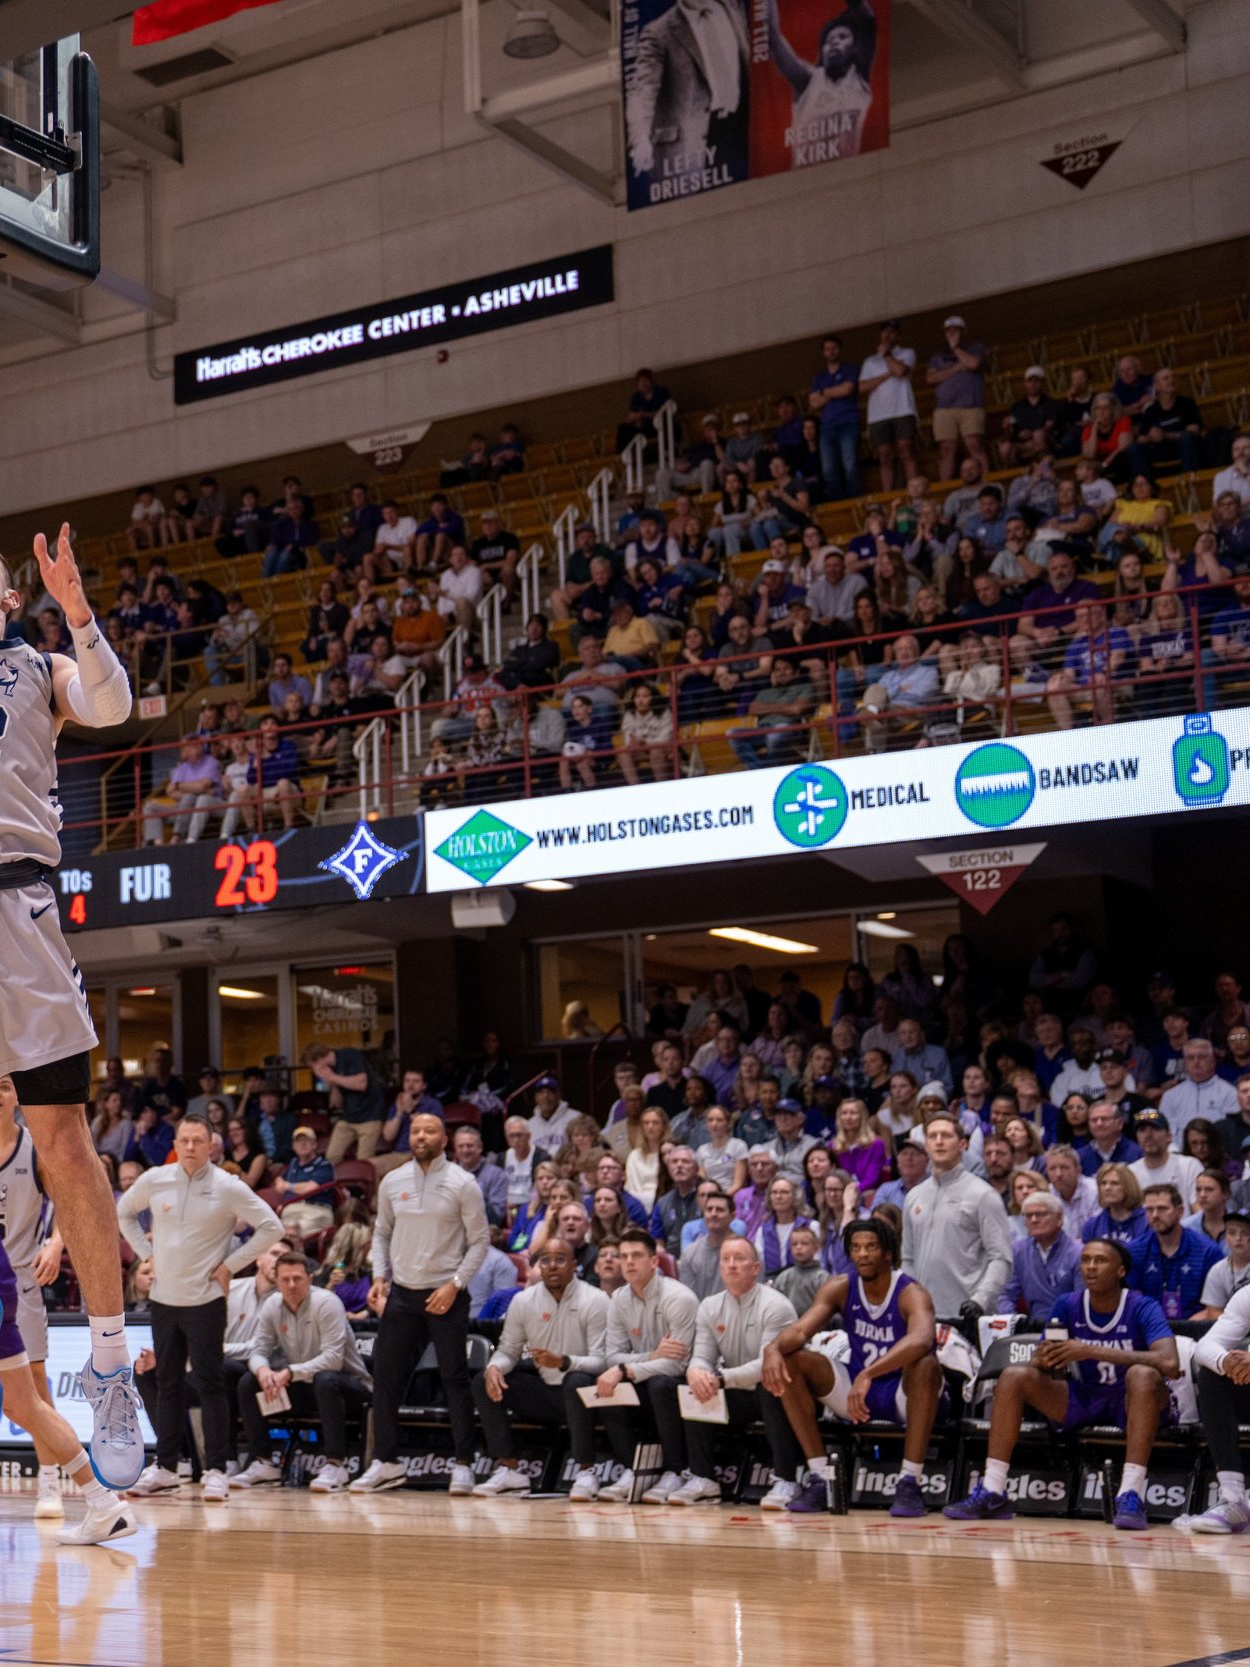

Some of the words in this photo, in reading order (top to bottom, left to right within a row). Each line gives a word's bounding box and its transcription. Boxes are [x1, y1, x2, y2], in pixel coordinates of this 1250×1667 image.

[795, 139, 840, 166] KIRK
[1053, 133, 1108, 153] Section
[1061, 150, 1100, 174] 222
[650, 163, 734, 202] DRIESELL
[261, 324, 364, 366] CHEROKEE
[367, 304, 446, 340] CENTER
[463, 270, 579, 317] ASHEVILLE
[1039, 758, 1140, 790] BANDSAW
[851, 782, 930, 810] MEDICAL
[536, 805, 754, 849] WWW.HOLSTONGASES.COM
[448, 830, 517, 858] HOLSTON
[214, 840, 278, 906] 23
[353, 848, 373, 873] F
[948, 850, 1013, 869] SECTION
[120, 863, 171, 904] FUR
[962, 869, 1002, 891] 122
[69, 894, 86, 925] 4
